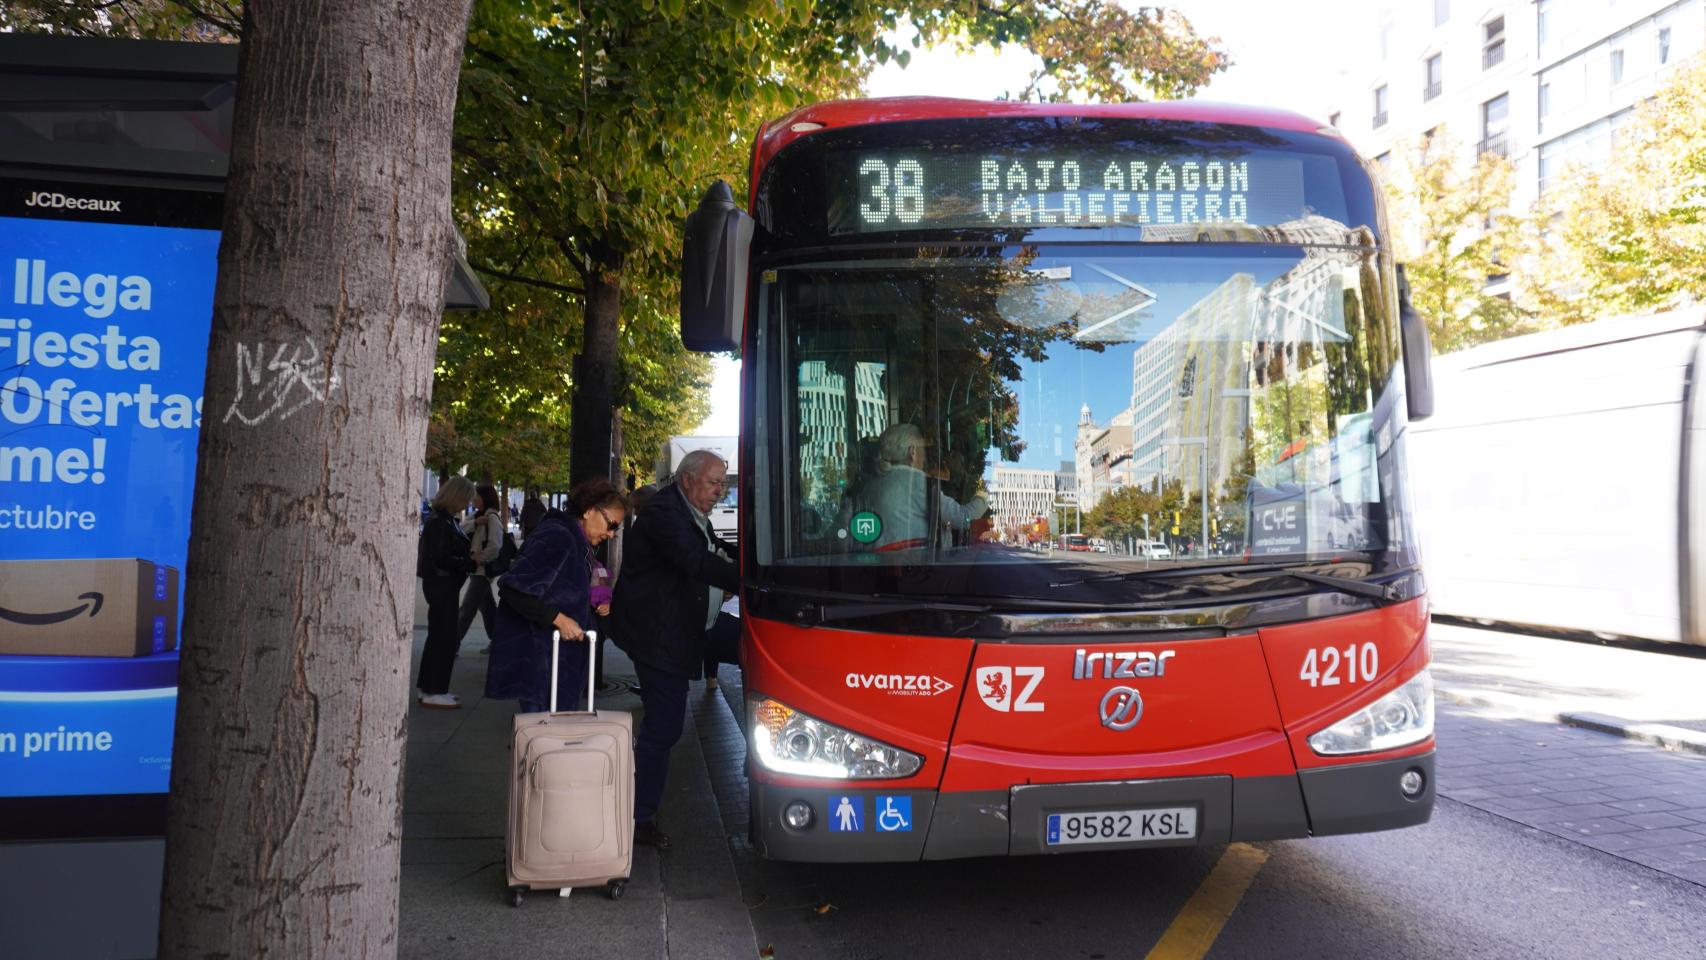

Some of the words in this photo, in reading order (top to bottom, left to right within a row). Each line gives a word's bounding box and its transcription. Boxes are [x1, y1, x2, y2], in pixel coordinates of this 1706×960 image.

[859, 159, 924, 223] 38
[981, 160, 1080, 191] BAJO
[1103, 161, 1249, 192] ARAGON
[25, 191, 121, 212] JCDecaux
[981, 193, 1249, 223] VALDEFIERRO
[14, 258, 152, 318] llega
[1300, 641, 1378, 688] 4210
[845, 672, 931, 690] avanza
[1014, 666, 1045, 712] Z
[23, 725, 113, 758] prime
[1066, 815, 1132, 840] 9582
[1141, 812, 1189, 837] KSL
